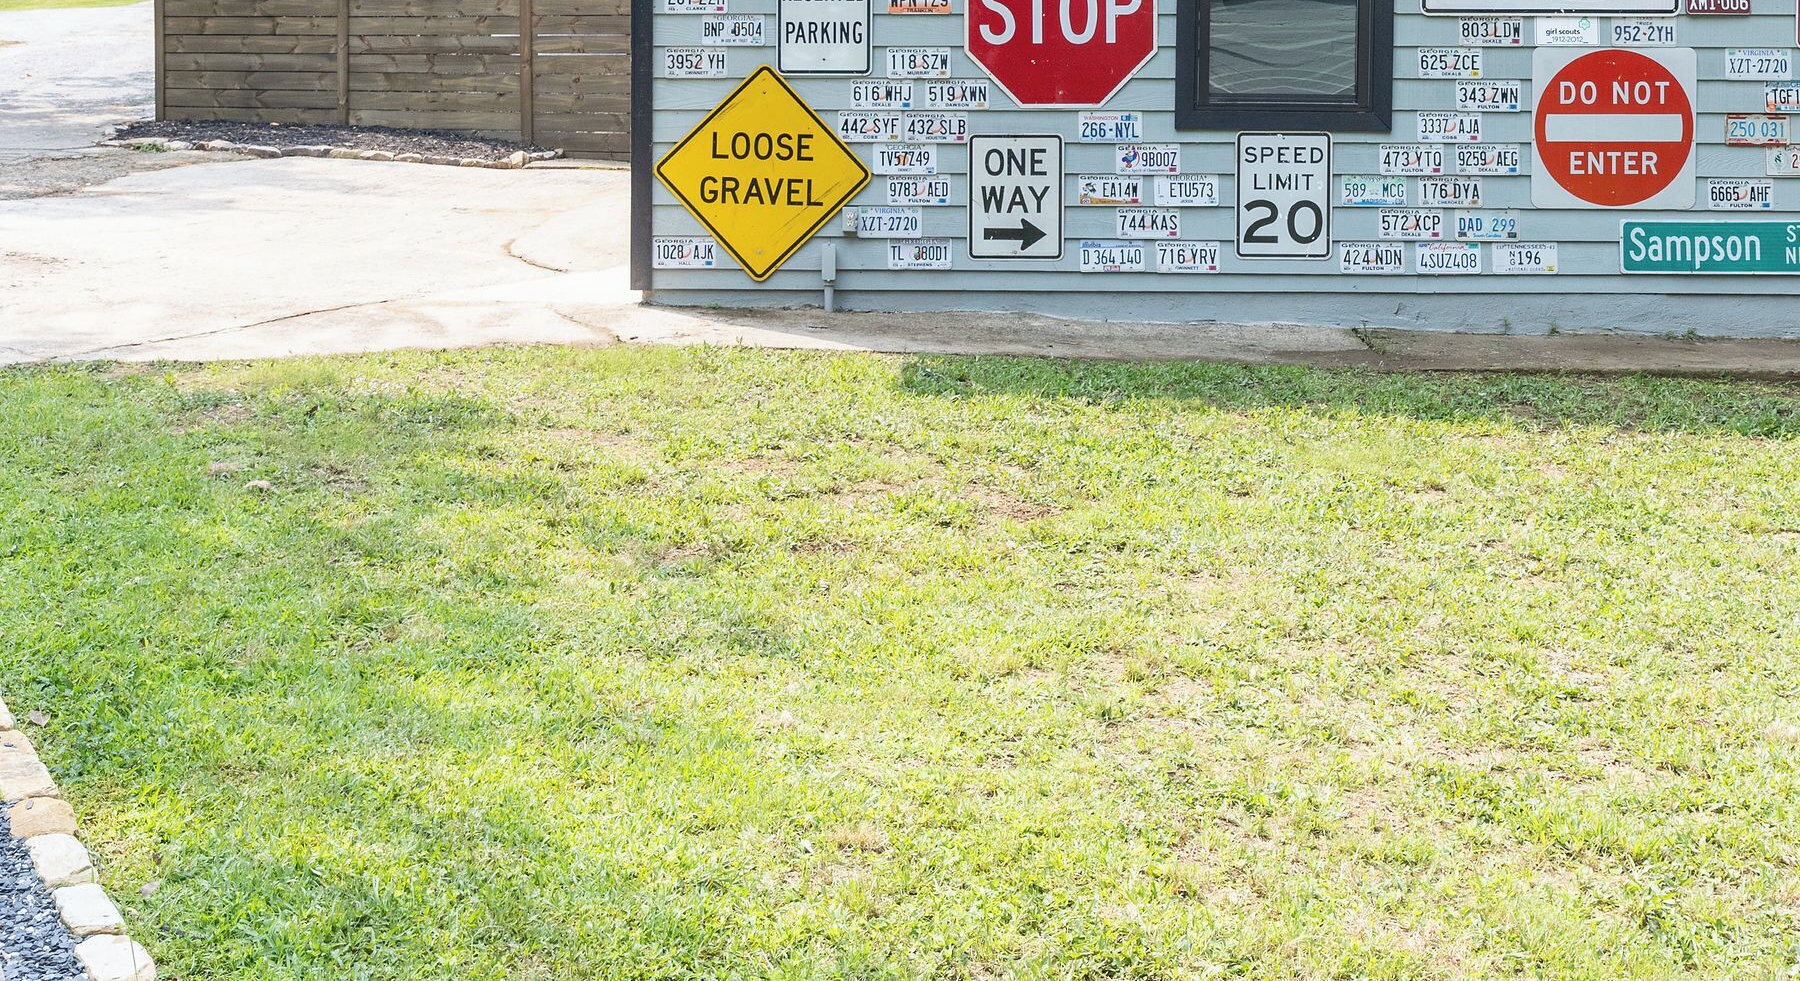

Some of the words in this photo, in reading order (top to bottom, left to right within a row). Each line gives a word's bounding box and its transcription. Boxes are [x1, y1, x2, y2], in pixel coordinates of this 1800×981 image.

[786, 22, 862, 44] PARKING
[1546, 28, 1558, 36] girl
[668, 54, 702, 69] 3952
[708, 54, 724, 69] YH
[1730, 58, 1787, 74] XZT-2720
[1560, 82, 1597, 104] DO
[1612, 82, 1670, 104] NOT
[1082, 122, 1140, 138] 266-NYL
[1421, 118, 1448, 134] 3337
[1459, 118, 1479, 134] AJA
[1730, 122, 1755, 137] 250
[1761, 122, 1784, 137] 031
[712, 132, 814, 161] LOOSE
[880, 152, 930, 166] TV57Z49
[984, 148, 1048, 176] ONE
[1244, 146, 1324, 164] SPEED
[1459, 152, 1486, 166] 9259
[1497, 152, 1518, 166] AEG
[1570, 152, 1658, 174] ENTER
[890, 182, 918, 197] 9783
[928, 182, 948, 197] AED
[1103, 182, 1137, 198] EA14W
[1170, 182, 1214, 198] ETU573
[1254, 174, 1314, 190] LIMIT
[700, 176, 824, 206] GRAVEL
[1344, 183, 1366, 198] 589
[1383, 183, 1404, 198] MCG
[1711, 186, 1739, 202] 6665
[1750, 186, 1770, 202] AHF
[981, 186, 1050, 214] WAY
[861, 216, 917, 232] XZT-2720
[1244, 200, 1322, 244] 20
[1460, 218, 1482, 232] DAD
[1492, 218, 1515, 232] 299
[656, 244, 684, 260] 1028
[693, 244, 714, 260] AJK
[1630, 228, 1760, 269] Sampson
[1420, 254, 1477, 268] 4SUZ408
